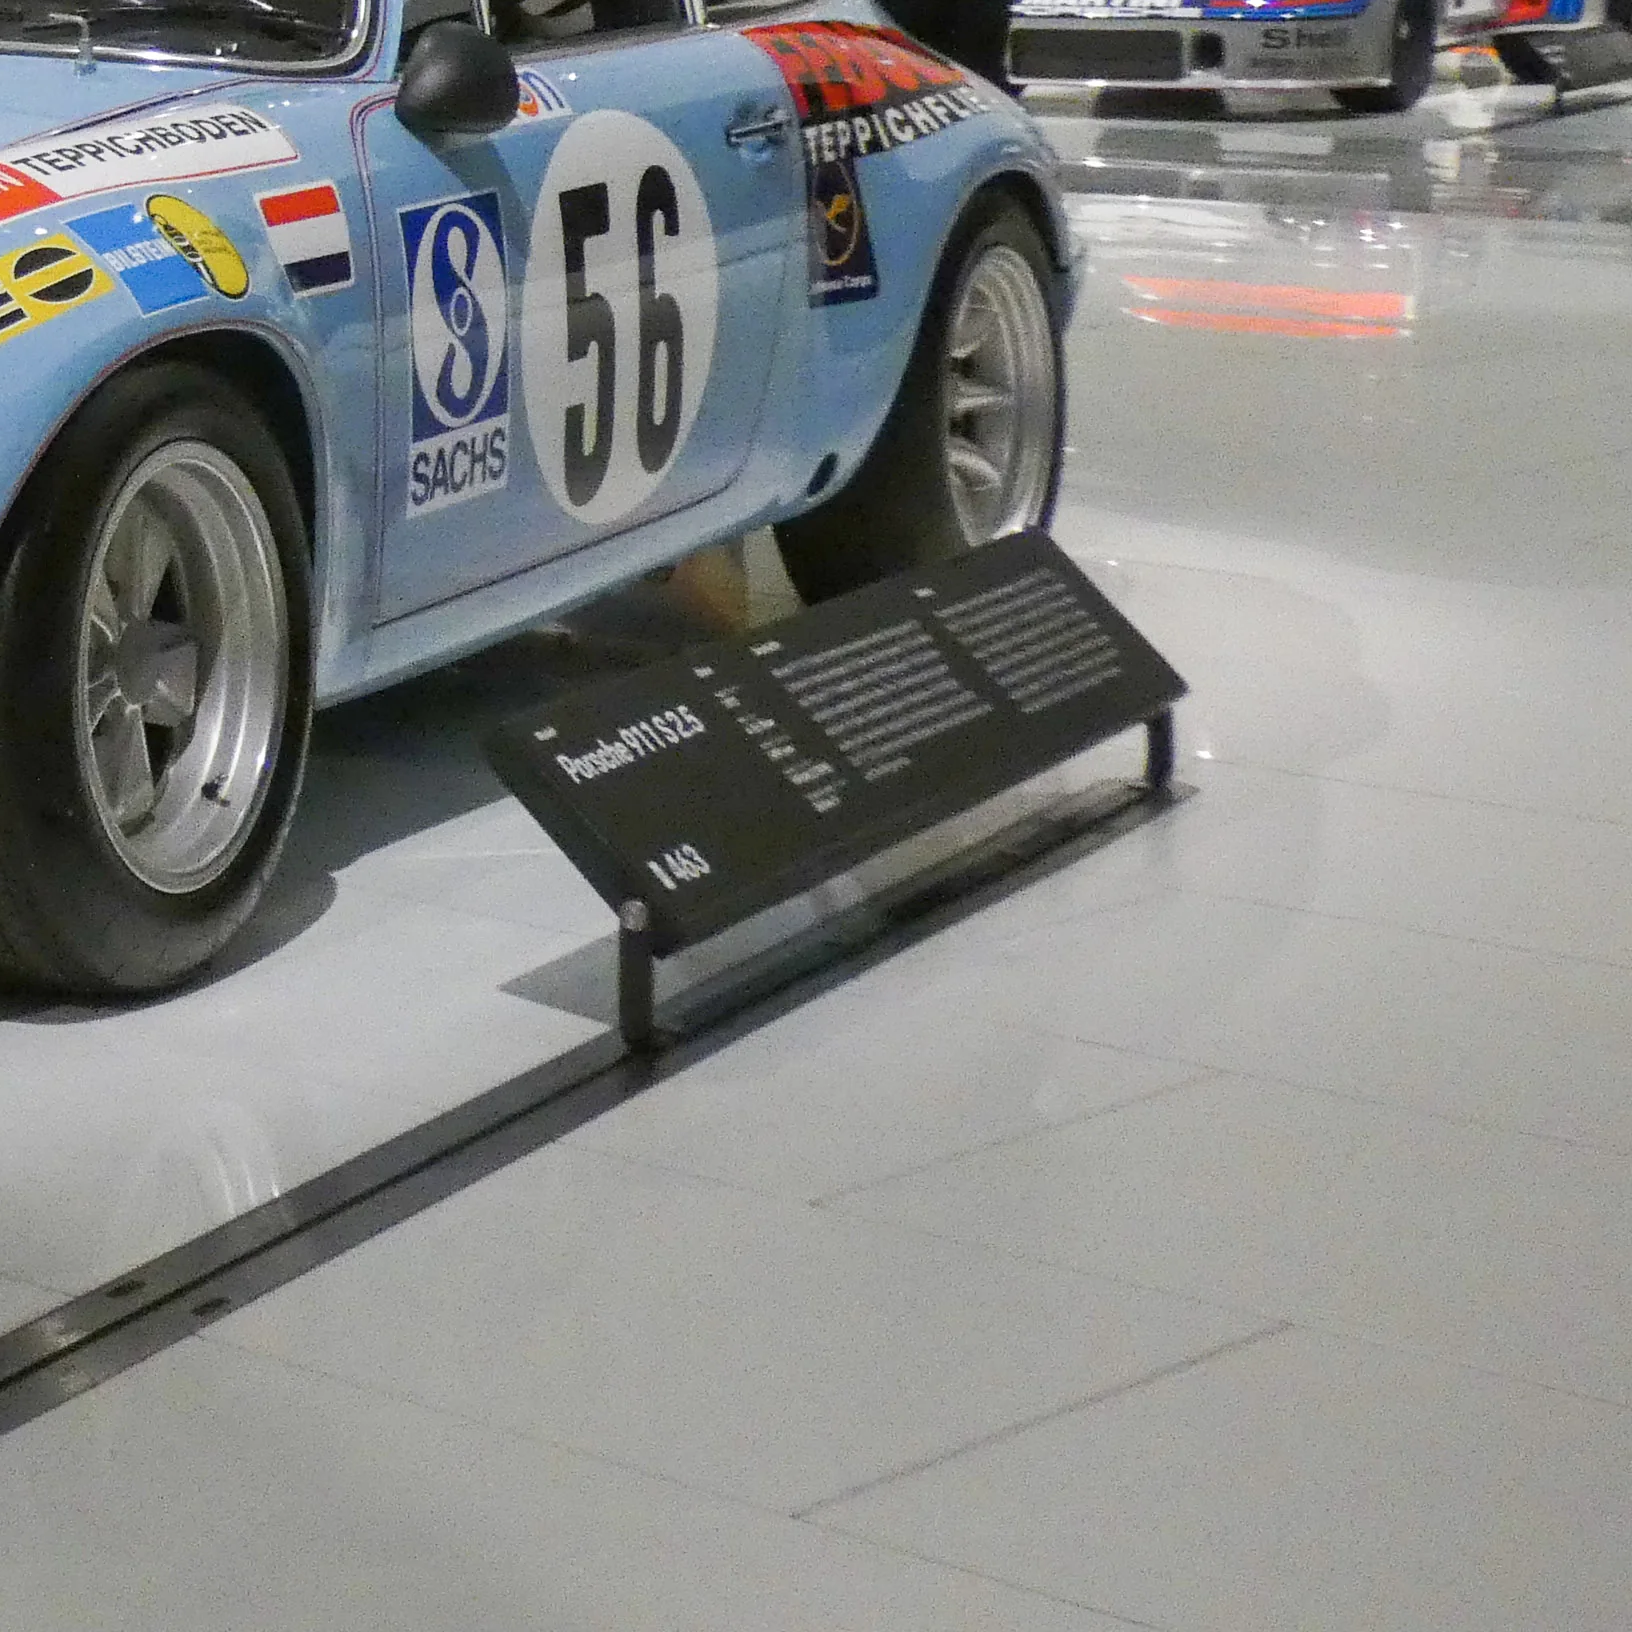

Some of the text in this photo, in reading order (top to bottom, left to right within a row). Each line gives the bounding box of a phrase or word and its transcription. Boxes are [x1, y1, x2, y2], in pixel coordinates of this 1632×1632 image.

[13, 109, 269, 177] TEPPICHBODEN
[557, 164, 685, 508] 56
[410, 428, 508, 507] SACHS
[556, 738, 635, 784] Porsche
